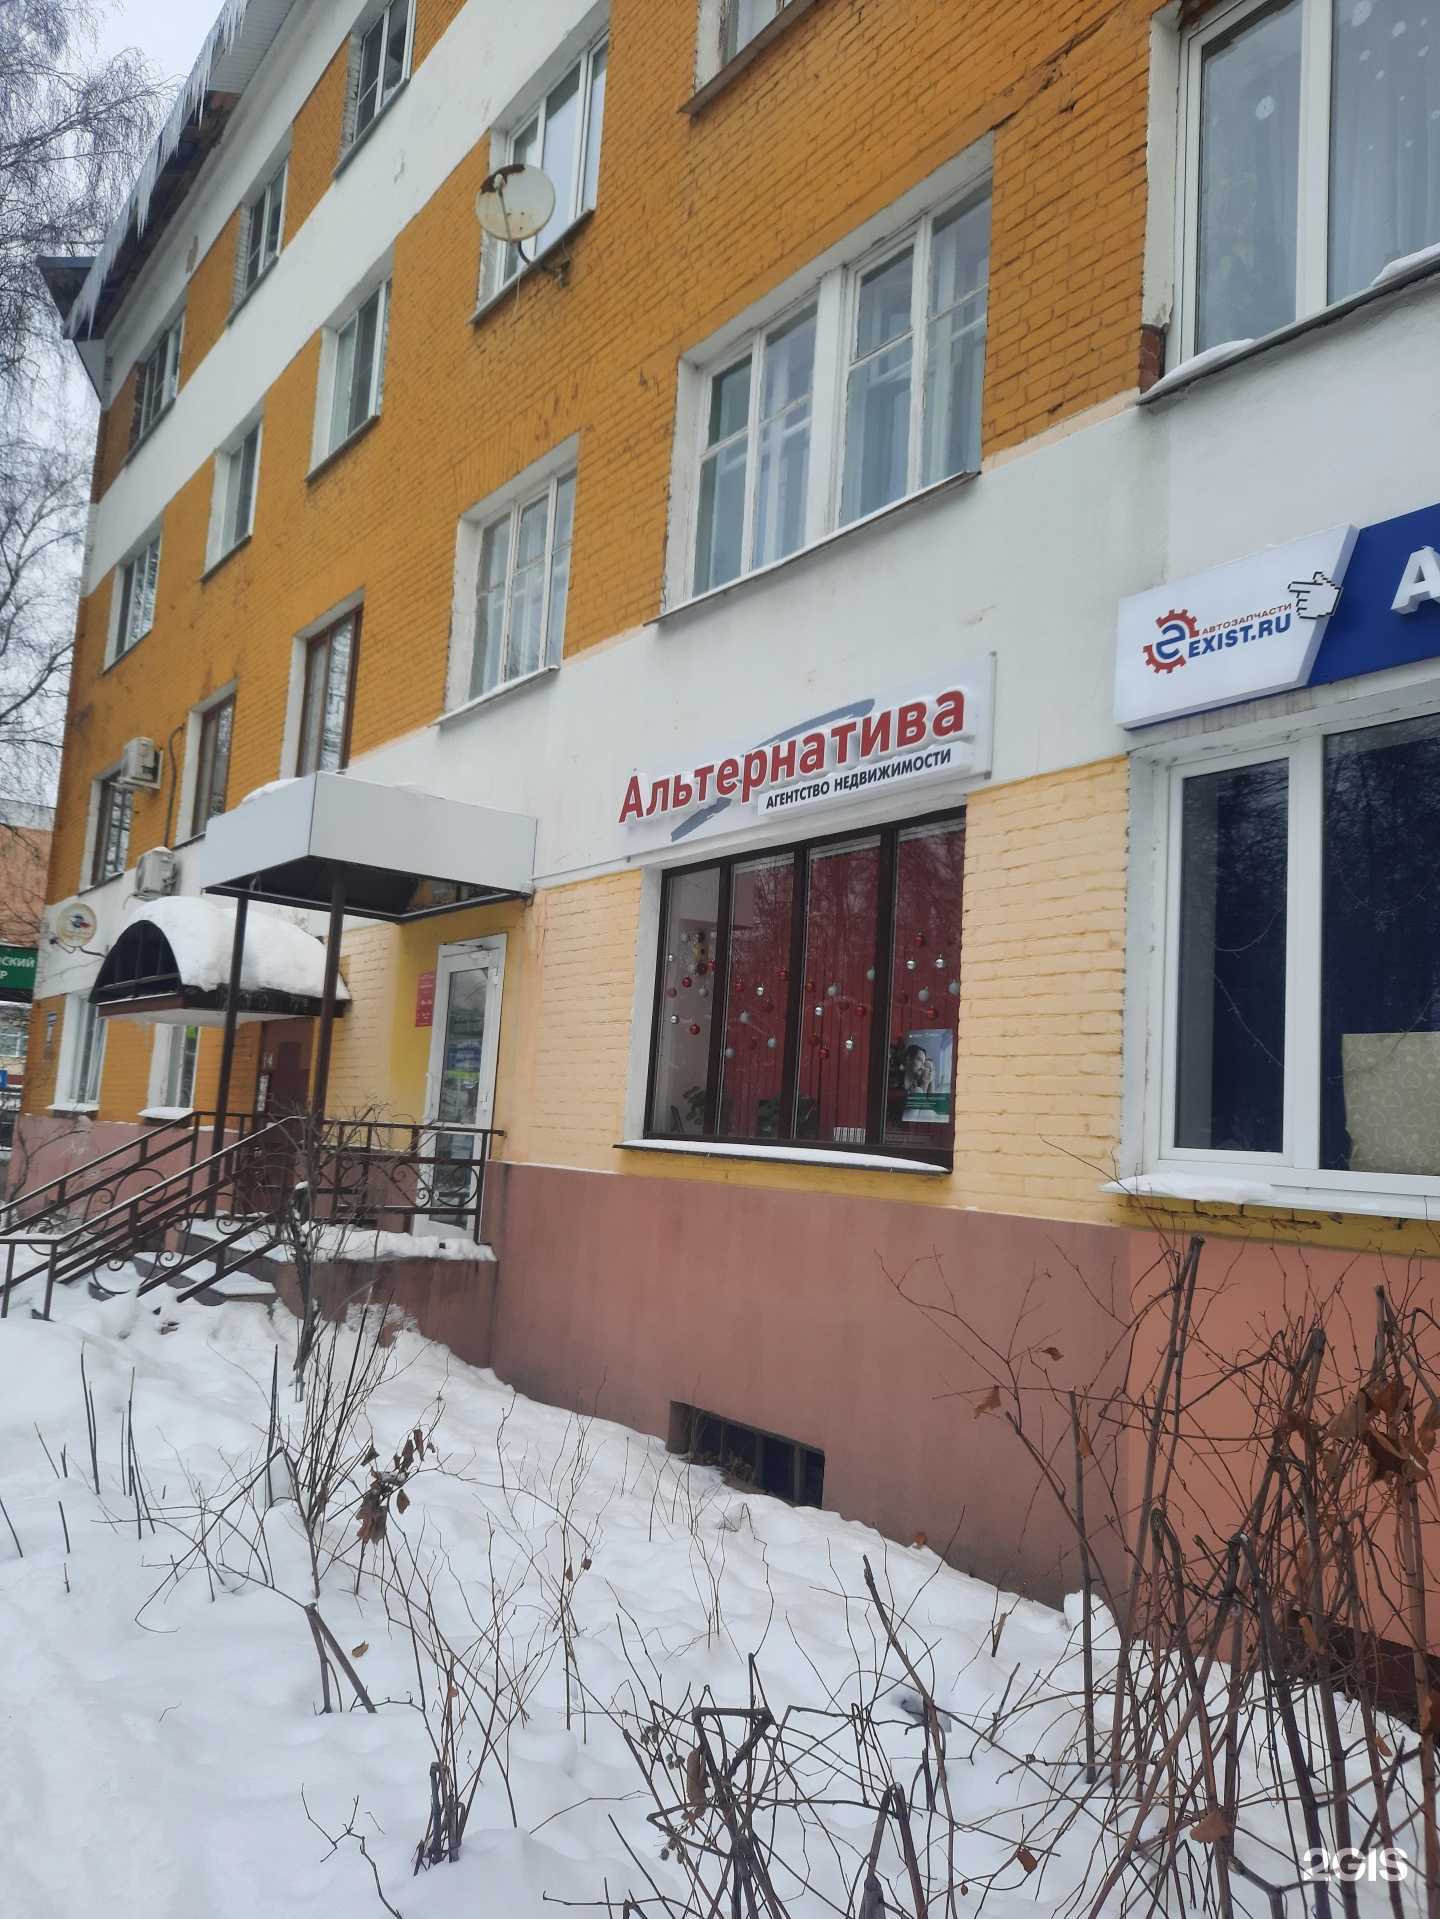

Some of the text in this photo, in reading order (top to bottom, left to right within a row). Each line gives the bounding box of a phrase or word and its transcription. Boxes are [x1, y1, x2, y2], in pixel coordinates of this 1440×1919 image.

[1187, 612, 1292, 659] EXIST.RU
[1201, 602, 1292, 636] АВТОЗАПЧАСТИ
[618, 688, 966, 824] Альтернатива
[765, 747, 953, 810] АГЕНТСТВО НЕДВИЖИМОСТИ
[0, 956, 36, 968] СКИЙ
